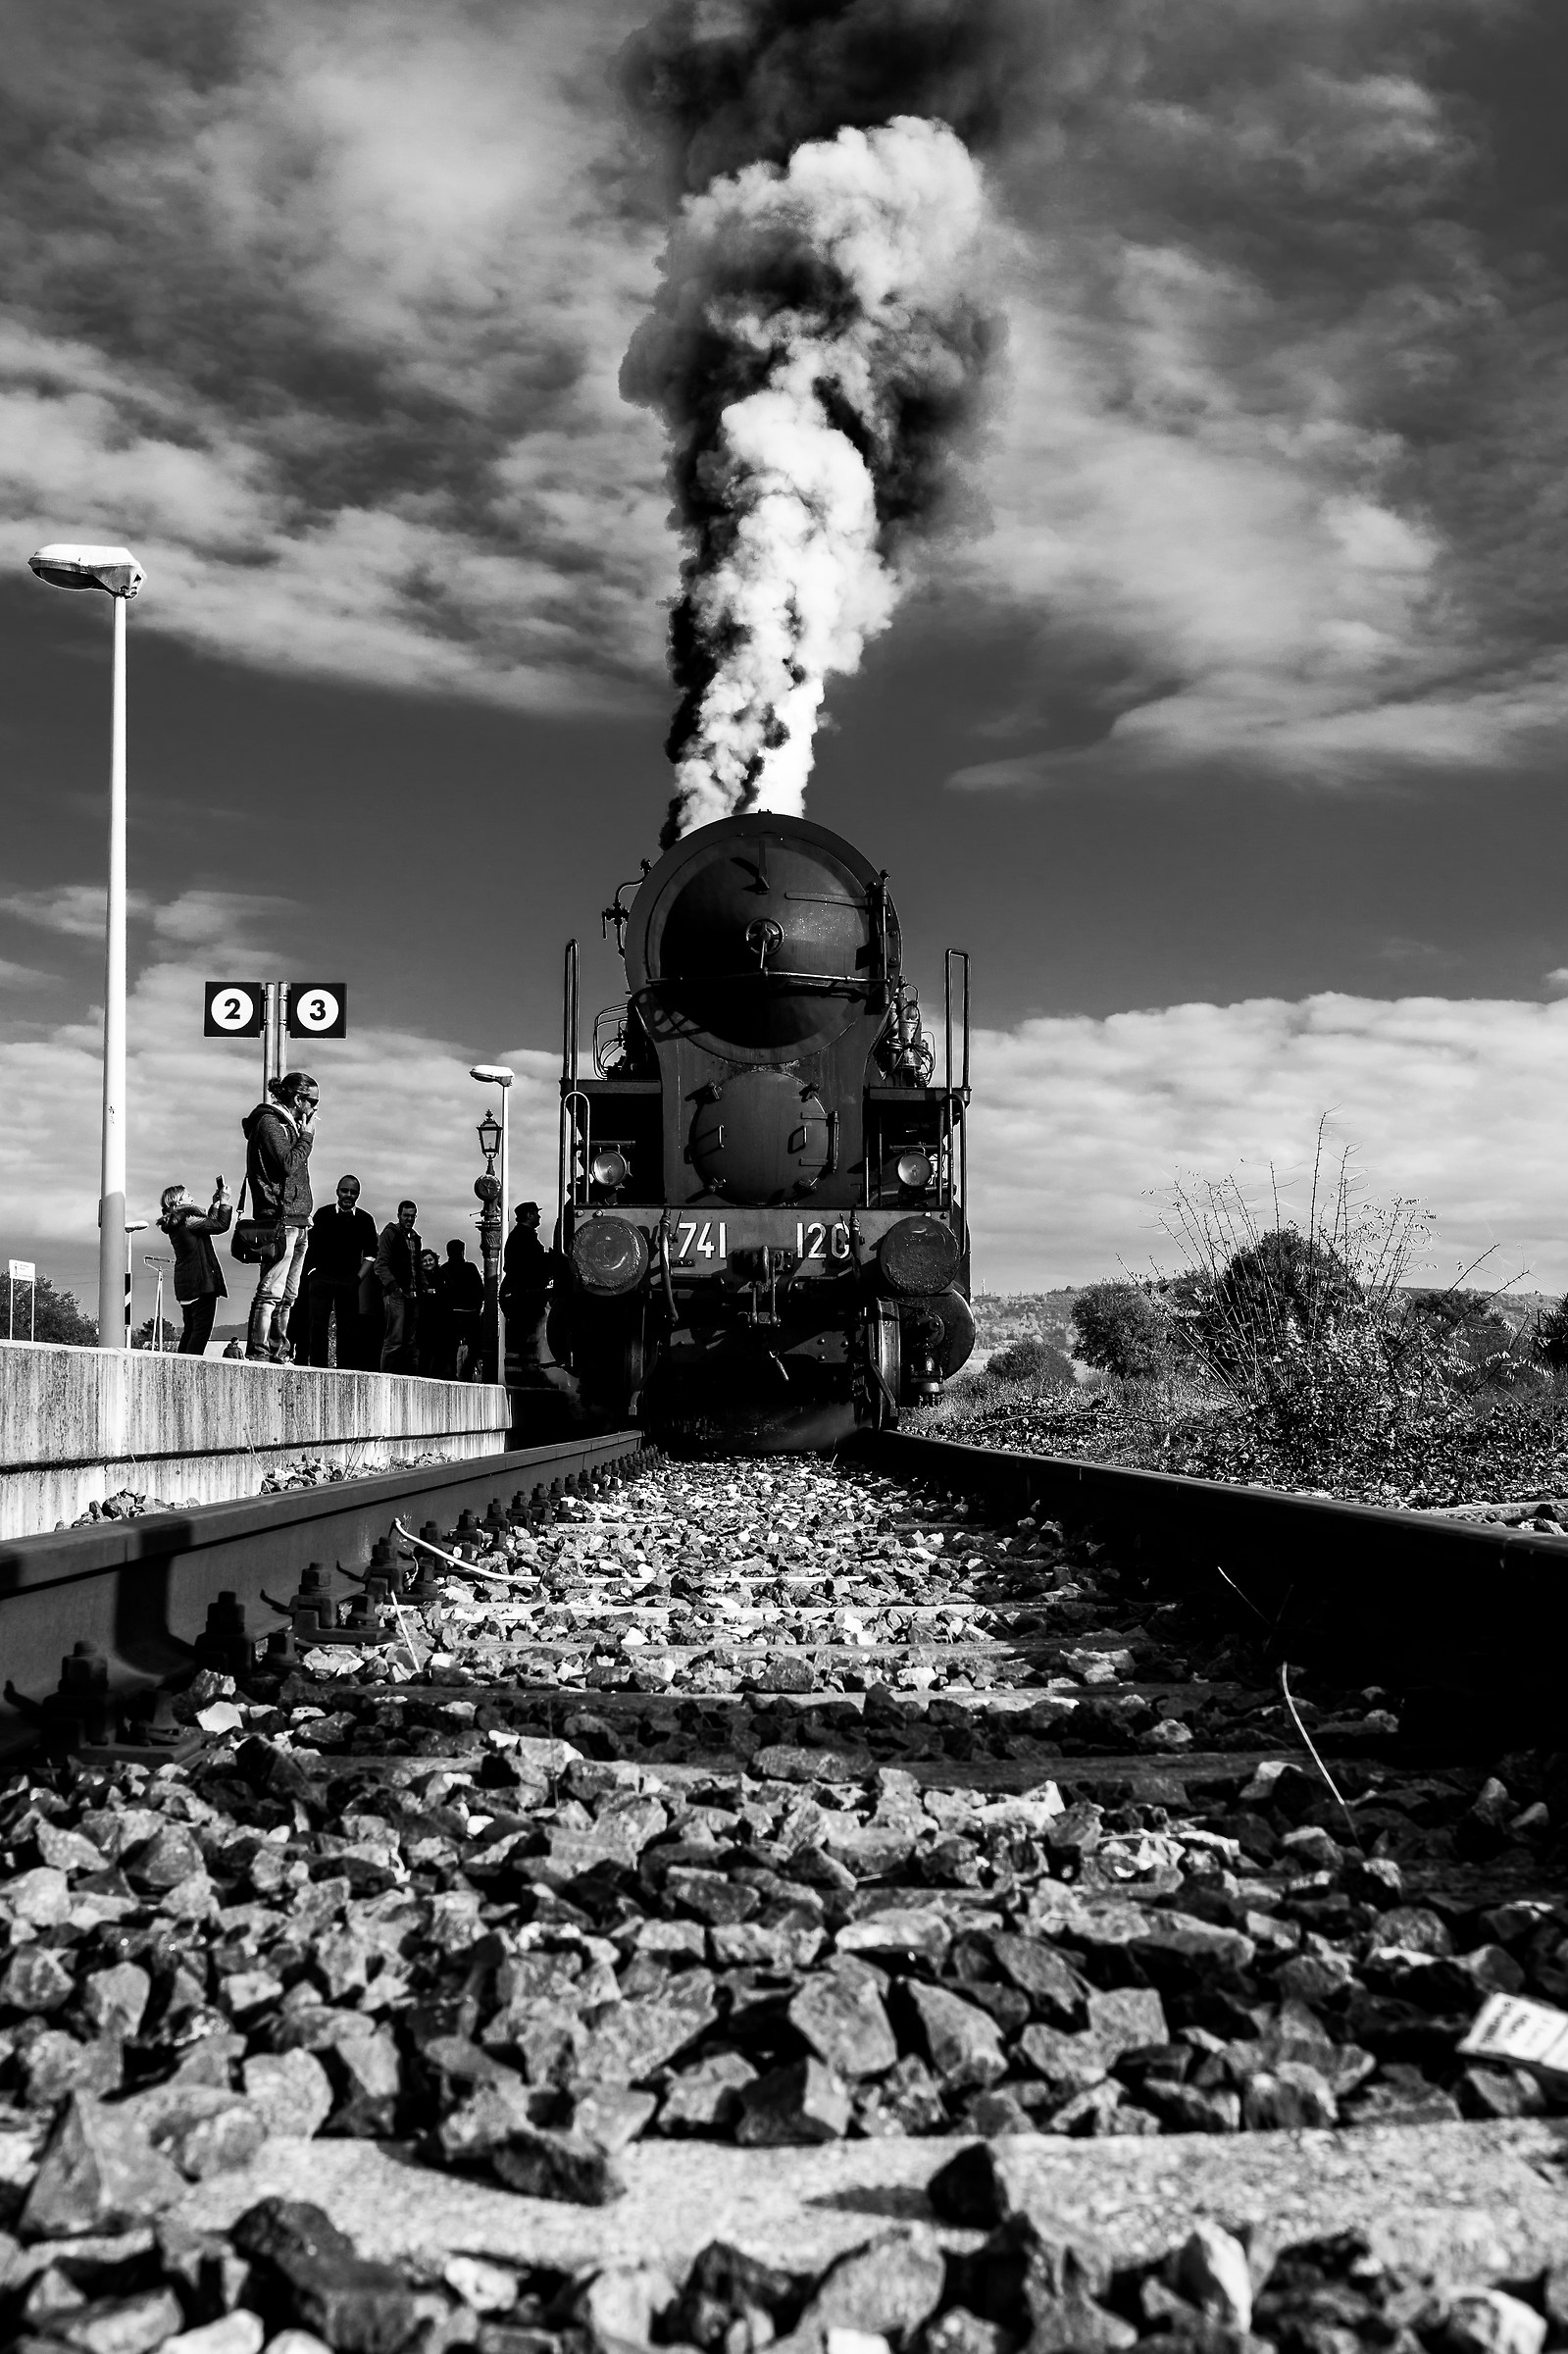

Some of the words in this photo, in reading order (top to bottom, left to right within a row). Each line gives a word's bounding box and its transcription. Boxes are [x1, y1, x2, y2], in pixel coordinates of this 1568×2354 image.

[224, 998, 241, 1020] 2
[309, 998, 327, 1021] 3
[678, 1222, 727, 1258] 741
[796, 1222, 850, 1259] 120
